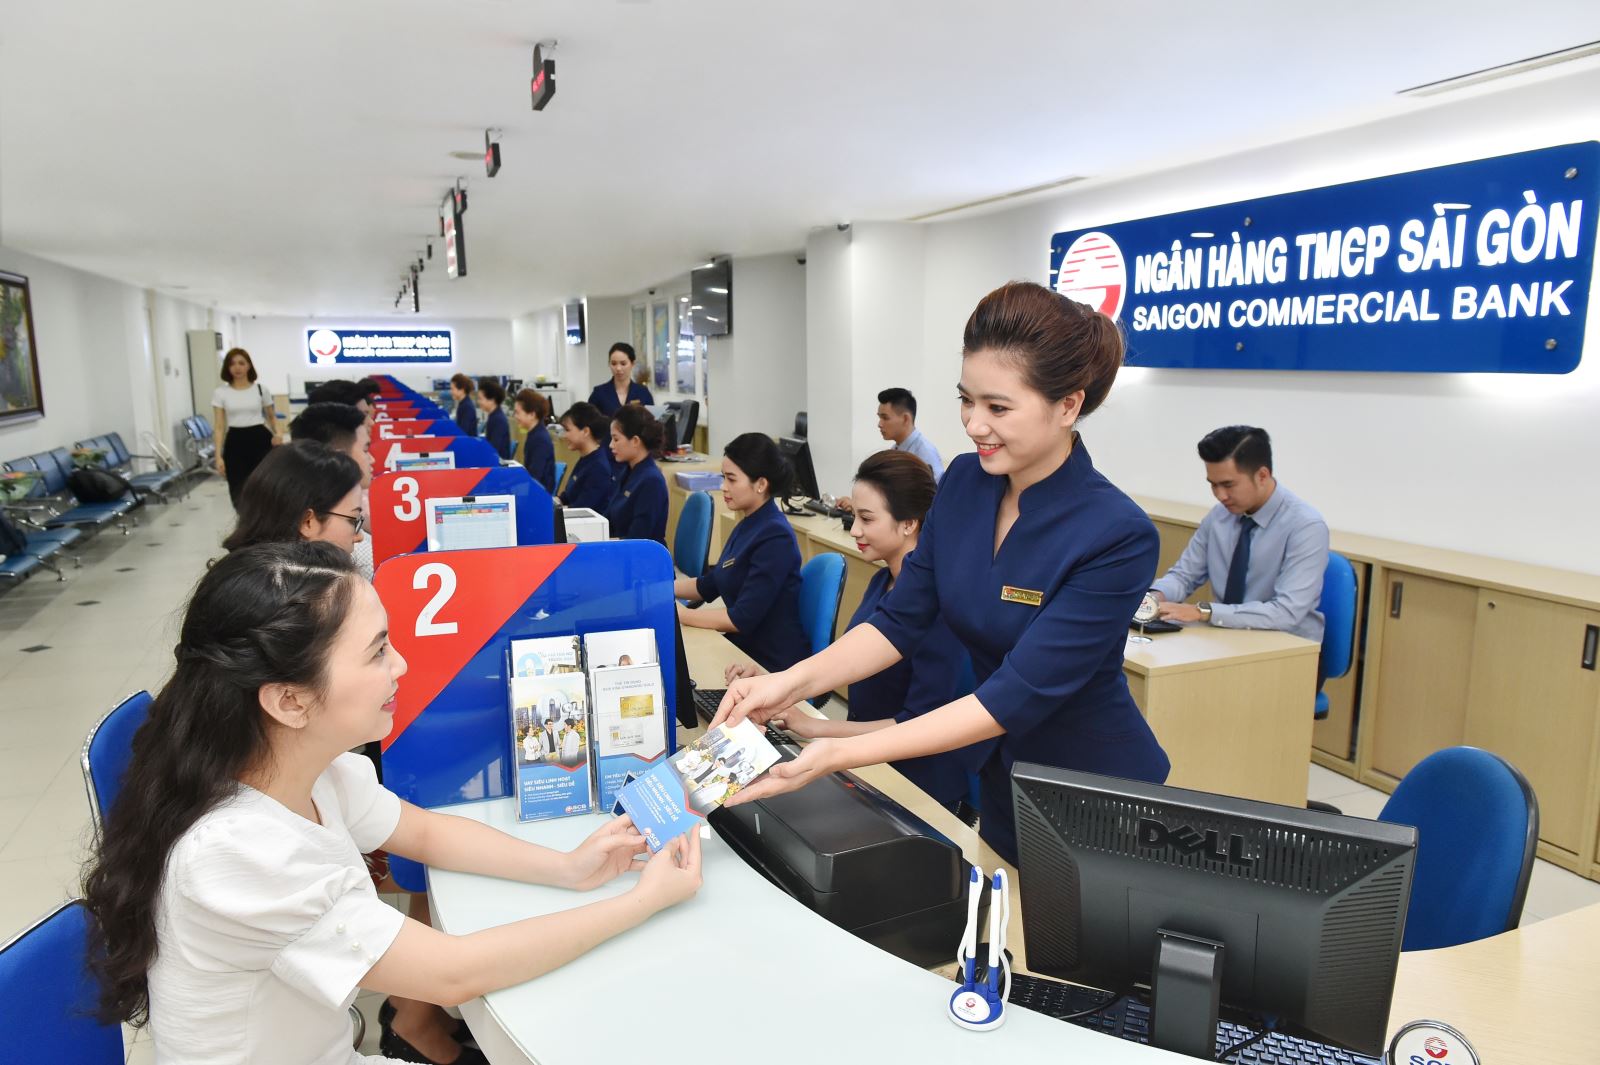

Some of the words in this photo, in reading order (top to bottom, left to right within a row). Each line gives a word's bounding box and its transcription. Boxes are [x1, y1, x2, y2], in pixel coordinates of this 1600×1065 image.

[1134, 239, 1203, 295] NGÂN
[1207, 231, 1288, 289] HÀNG
[1397, 203, 1468, 273] SÀI
[1476, 189, 1583, 267] GÒN
[1132, 301, 1221, 332] SAIGON
[1227, 288, 1440, 328] COMMERCIAL
[1451, 279, 1574, 321] BANK
[384, 442, 401, 472] 4
[392, 476, 422, 522] 3
[412, 562, 459, 637] 2
[1138, 817, 1254, 867] DELL
